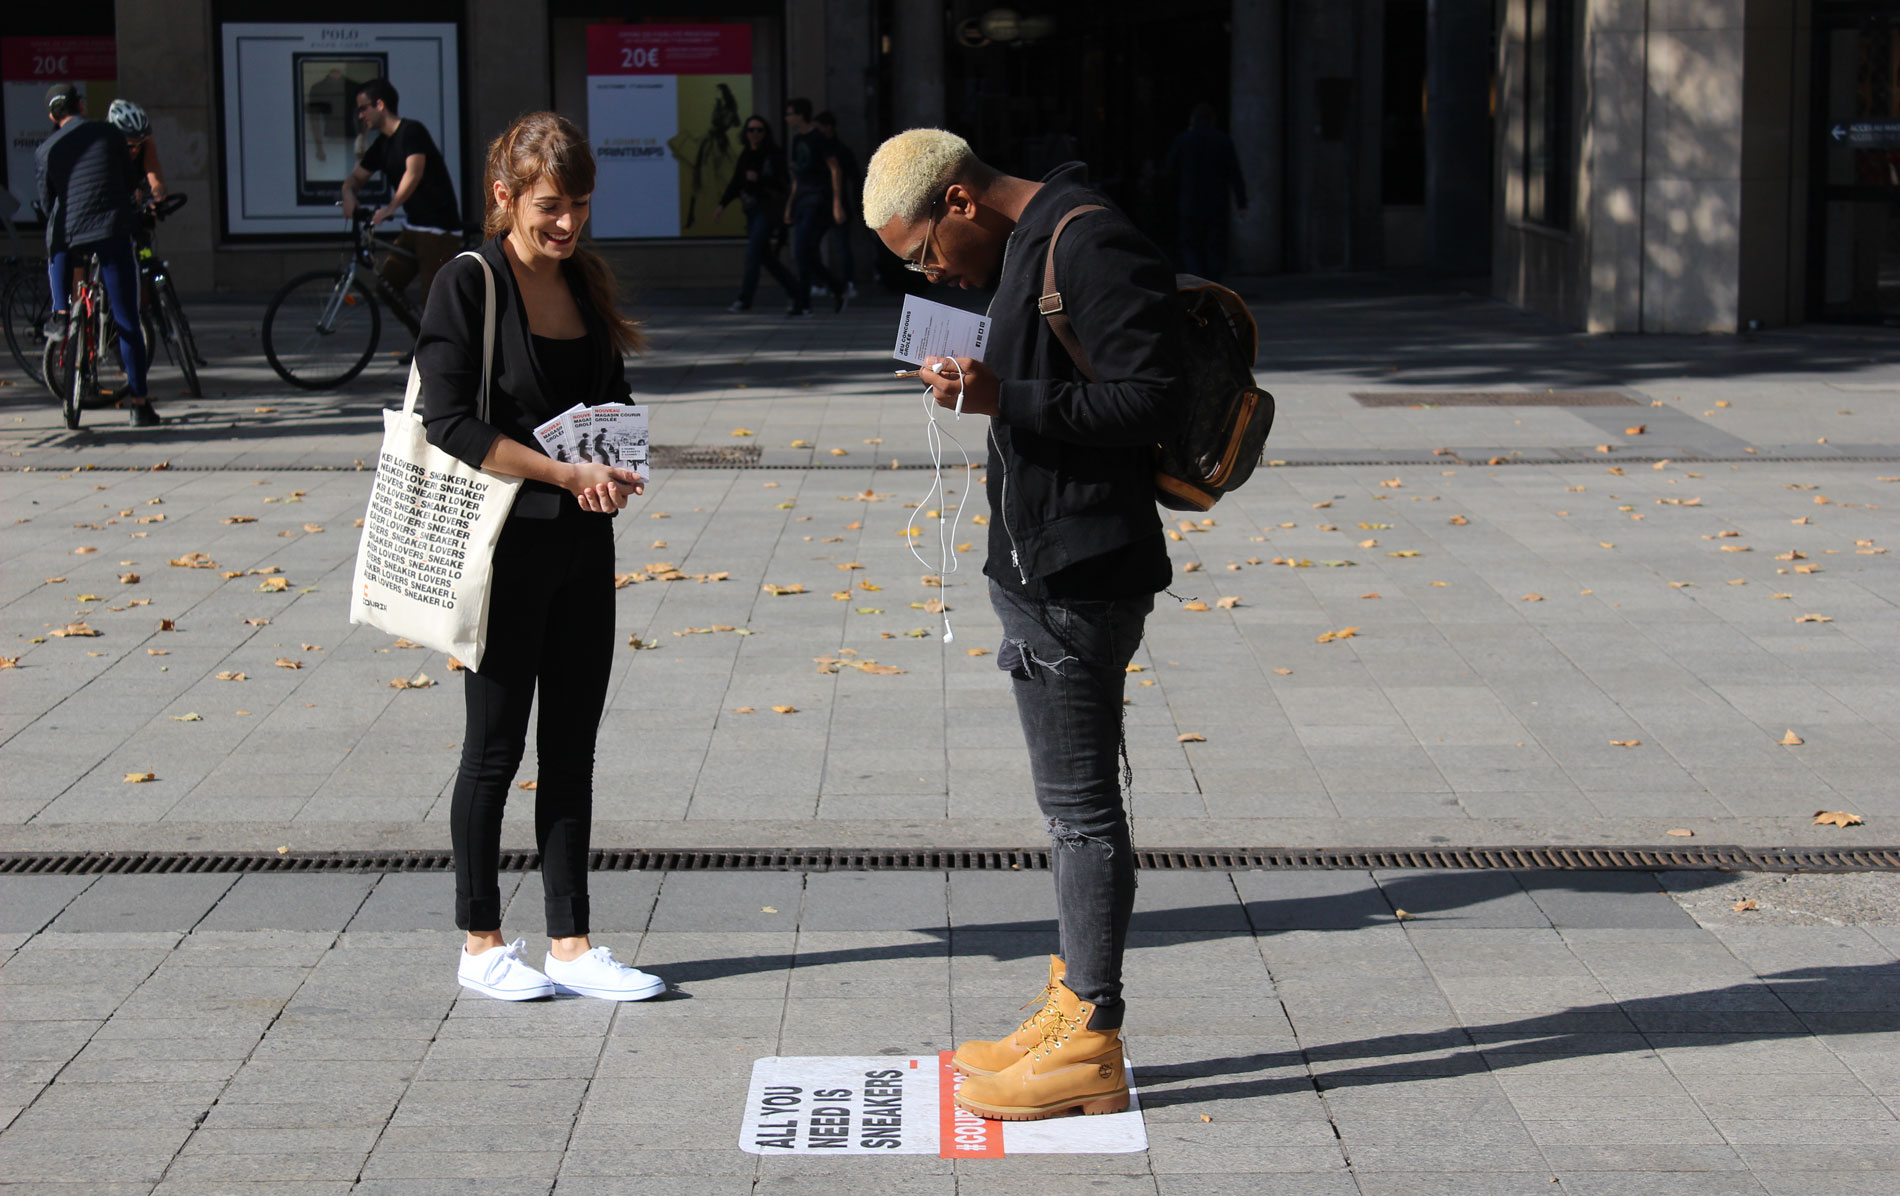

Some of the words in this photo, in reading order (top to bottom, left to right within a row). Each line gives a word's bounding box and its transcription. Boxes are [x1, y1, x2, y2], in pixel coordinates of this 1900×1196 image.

[321, 28, 359, 40] POLO
[33, 55, 68, 74] 20€
[621, 47, 660, 68] 20€
[598, 146, 664, 157] PRINTEMPS
[902, 311, 911, 342] CONCOURS
[430, 472, 467, 486] SNEAKER
[469, 480, 488, 492] LOV
[440, 484, 484, 502] SNEAKER
[449, 496, 480, 510] LOVER
[420, 500, 458, 516] SNEAKER
[460, 510, 481, 521] LOV
[420, 531, 459, 548] SNEAKER
[426, 522, 470, 540] SNEAKER
[392, 532, 428, 550] SNEAKER
[430, 544, 466, 560] LOVERS
[384, 560, 416, 580] SNEAKER
[408, 559, 447, 576] SNEAKER
[449, 570, 462, 580] LO
[428, 554, 464, 570] SNEAKE
[405, 588, 440, 606] SNEAKER
[442, 600, 454, 610] LO
[411, 580, 450, 598] SNEAKER
[760, 1086, 803, 1116] YOU
[813, 1088, 852, 1102] IS
[755, 1120, 798, 1148] ALL
[808, 1107, 850, 1148] NEED
